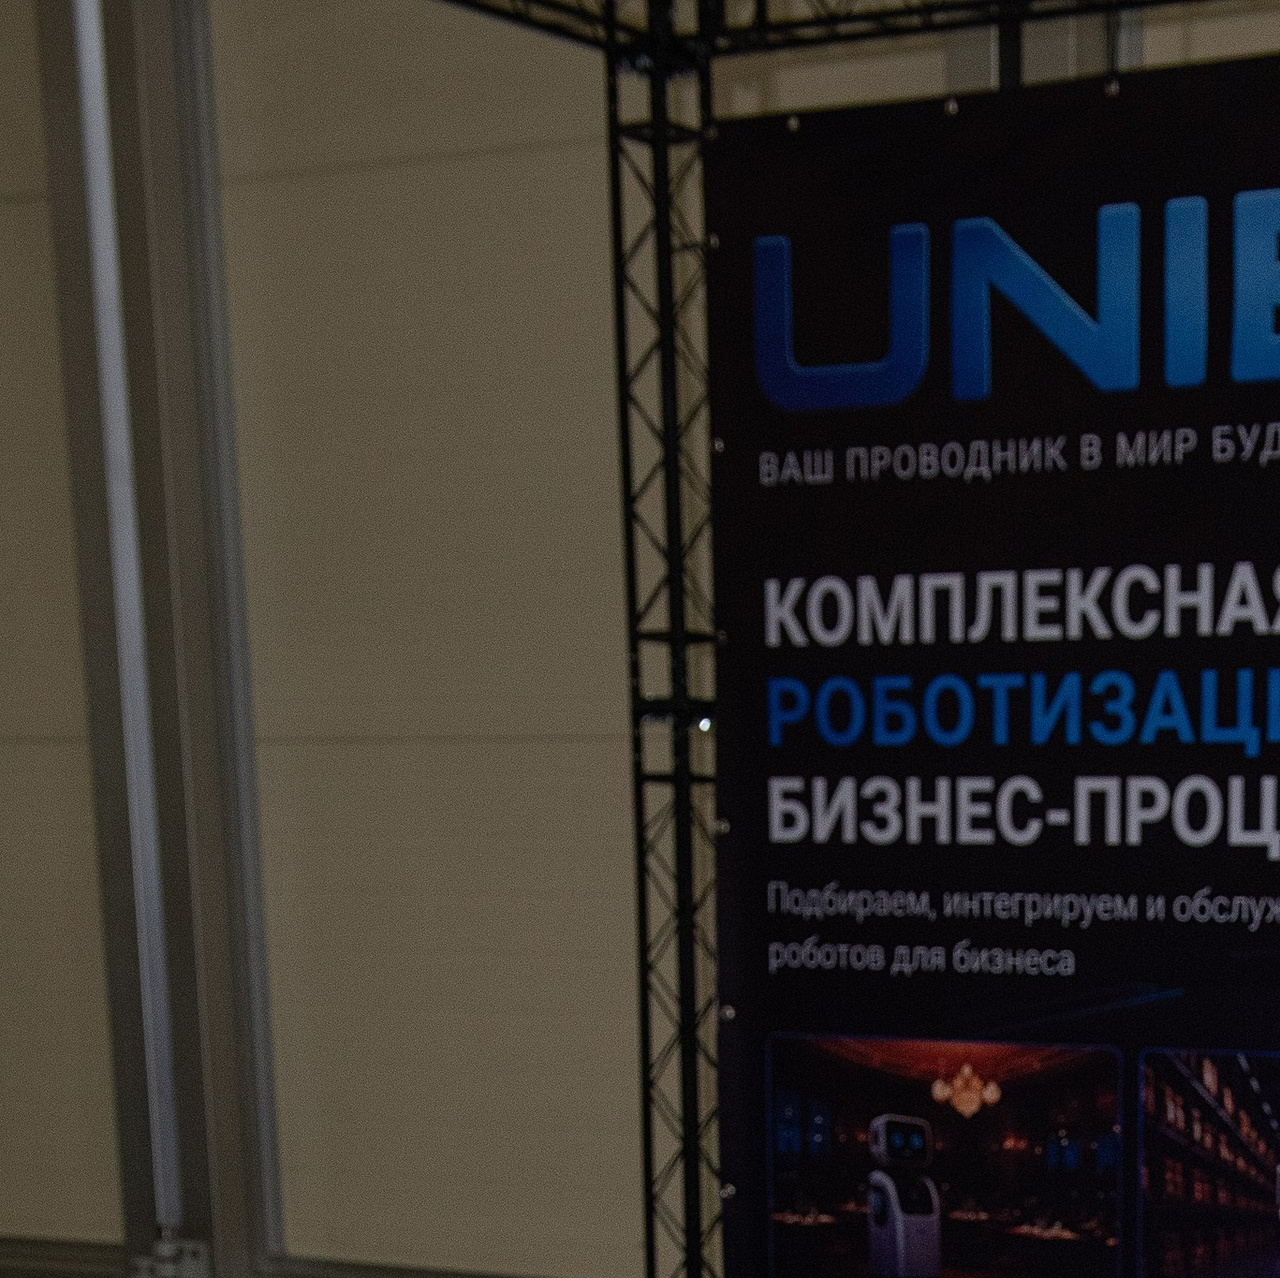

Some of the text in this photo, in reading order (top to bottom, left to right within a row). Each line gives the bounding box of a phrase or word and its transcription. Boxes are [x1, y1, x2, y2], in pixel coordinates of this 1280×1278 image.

[758, 449, 834, 486] ВАШ
[845, 435, 1067, 481] ПРОВОДНИК
[1080, 433, 1102, 470] В
[1116, 427, 1198, 466] МИР
[767, 880, 937, 922] Подбираем,
[943, 891, 1139, 929] интегрируем
[1145, 895, 1166, 920] и
[768, 935, 1076, 977] роботов для бизнеса
